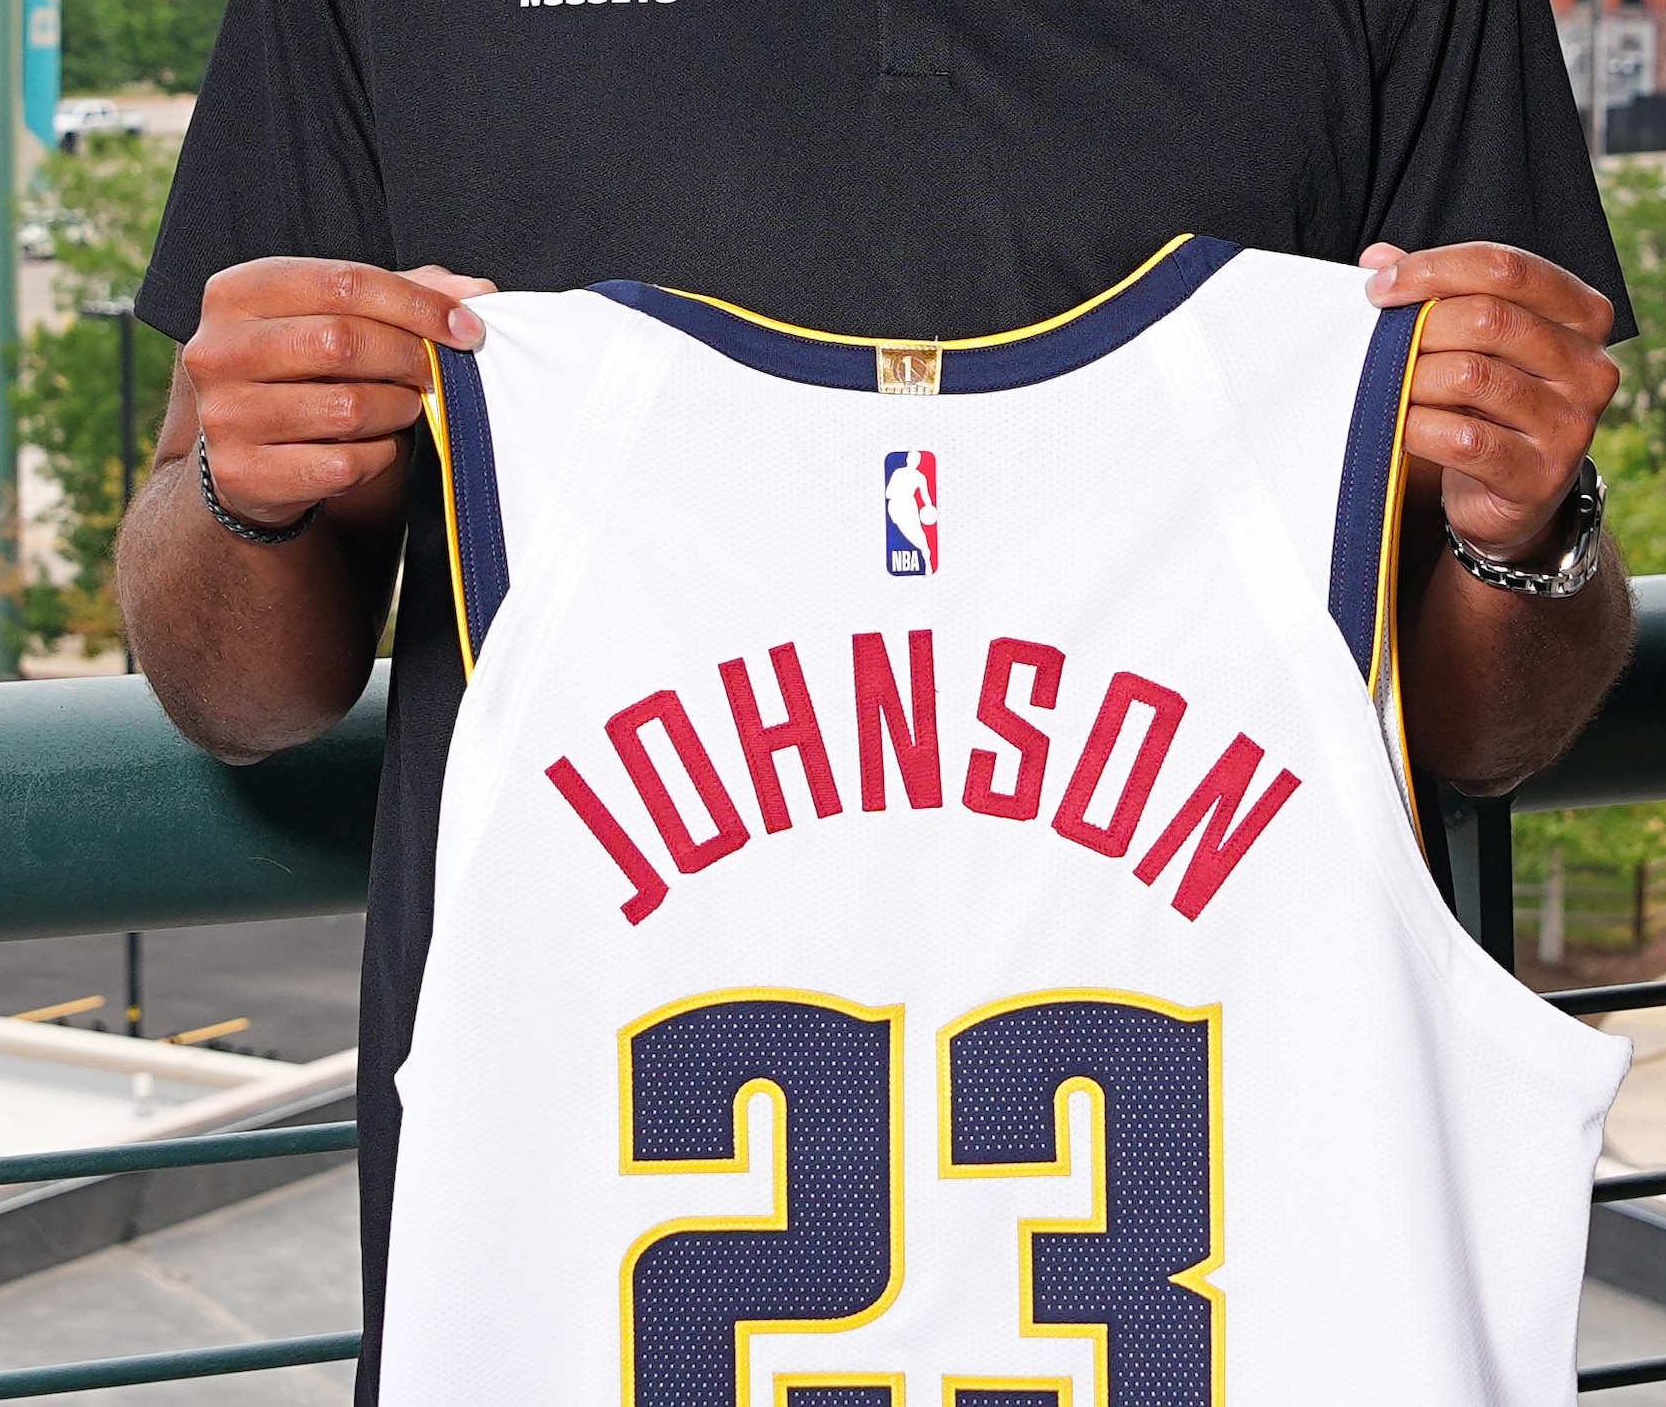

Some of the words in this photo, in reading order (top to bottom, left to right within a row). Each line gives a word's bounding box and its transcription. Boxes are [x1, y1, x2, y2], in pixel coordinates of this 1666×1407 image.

[891, 549, 921, 573] NBA
[544, 628, 1303, 926] JOHNSON
[616, 985, 1227, 1407] 23
